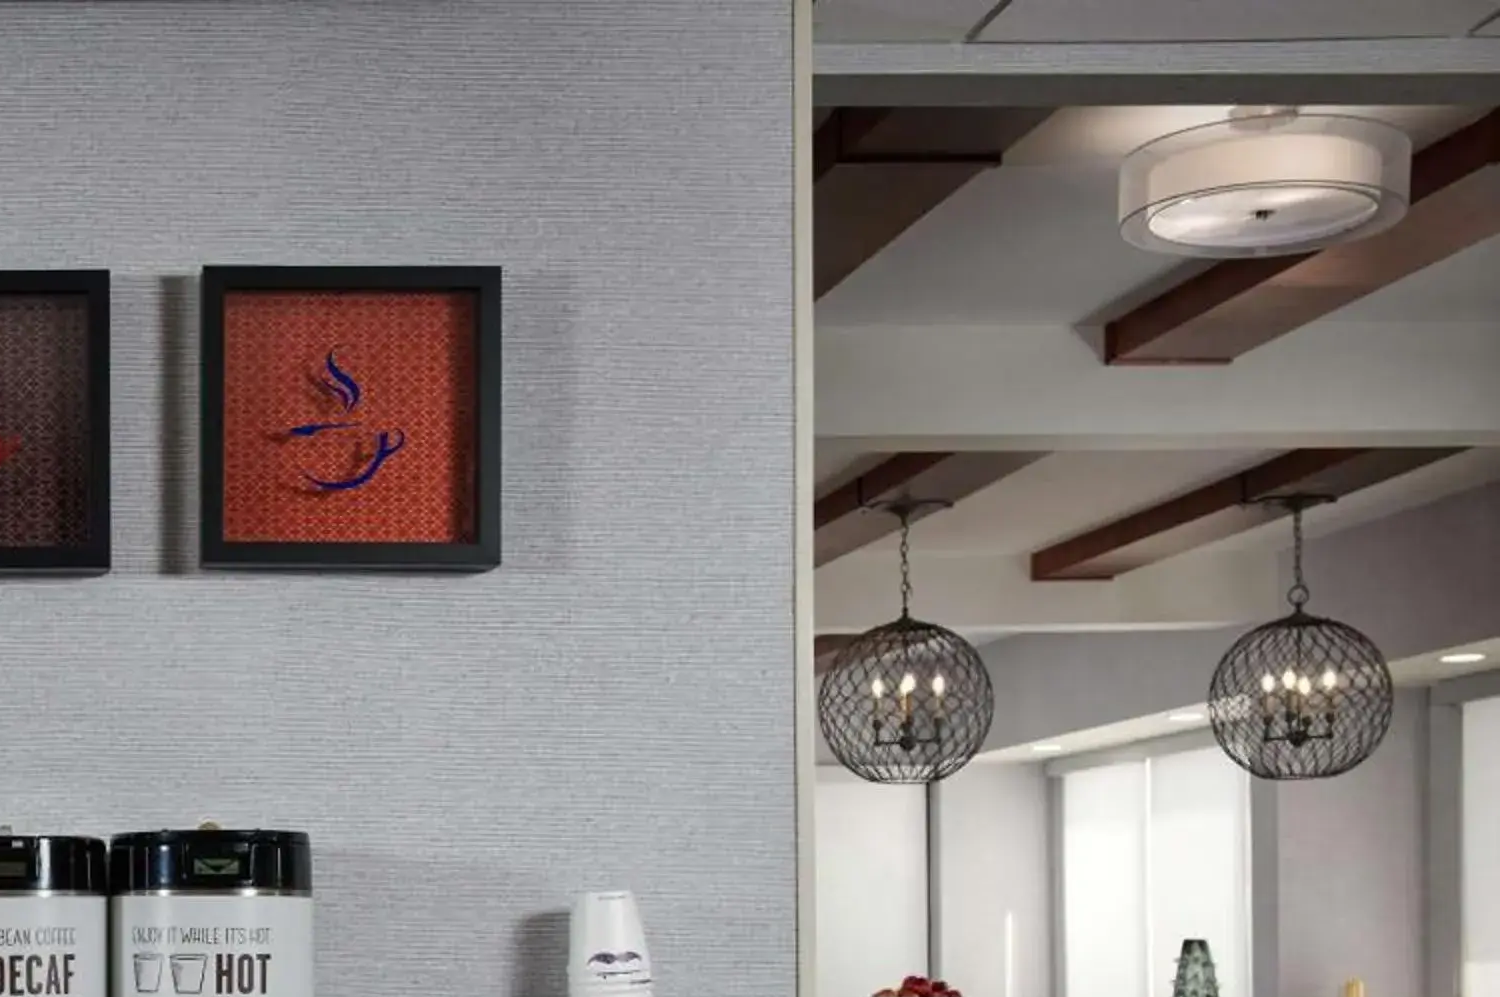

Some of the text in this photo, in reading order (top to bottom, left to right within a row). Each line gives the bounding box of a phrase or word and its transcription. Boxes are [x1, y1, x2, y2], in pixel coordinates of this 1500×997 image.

[35, 927, 77, 946] COFFEE
[180, 927, 219, 945] WHILE
[215, 953, 272, 995] HOT
